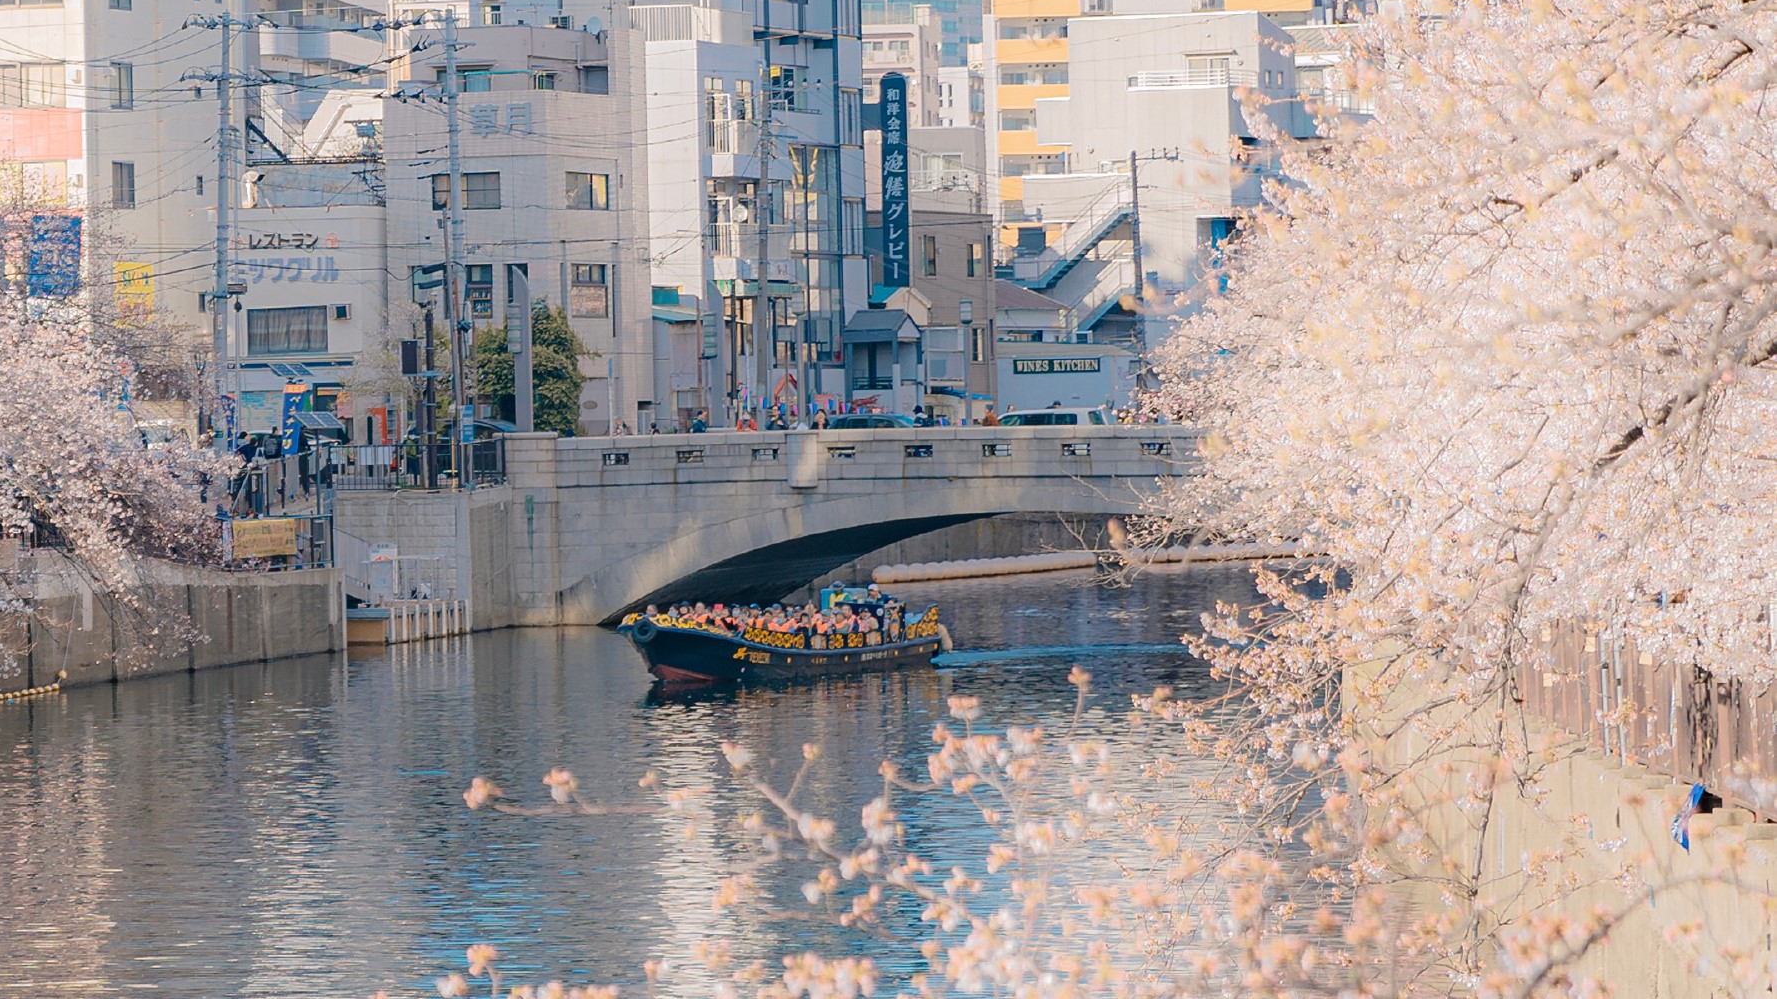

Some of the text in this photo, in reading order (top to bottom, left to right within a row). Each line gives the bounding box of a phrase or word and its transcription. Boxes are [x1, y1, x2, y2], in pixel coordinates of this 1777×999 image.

[248, 232, 319, 250] レストラン
[1016, 359, 1099, 373] WINES KITCHEN
